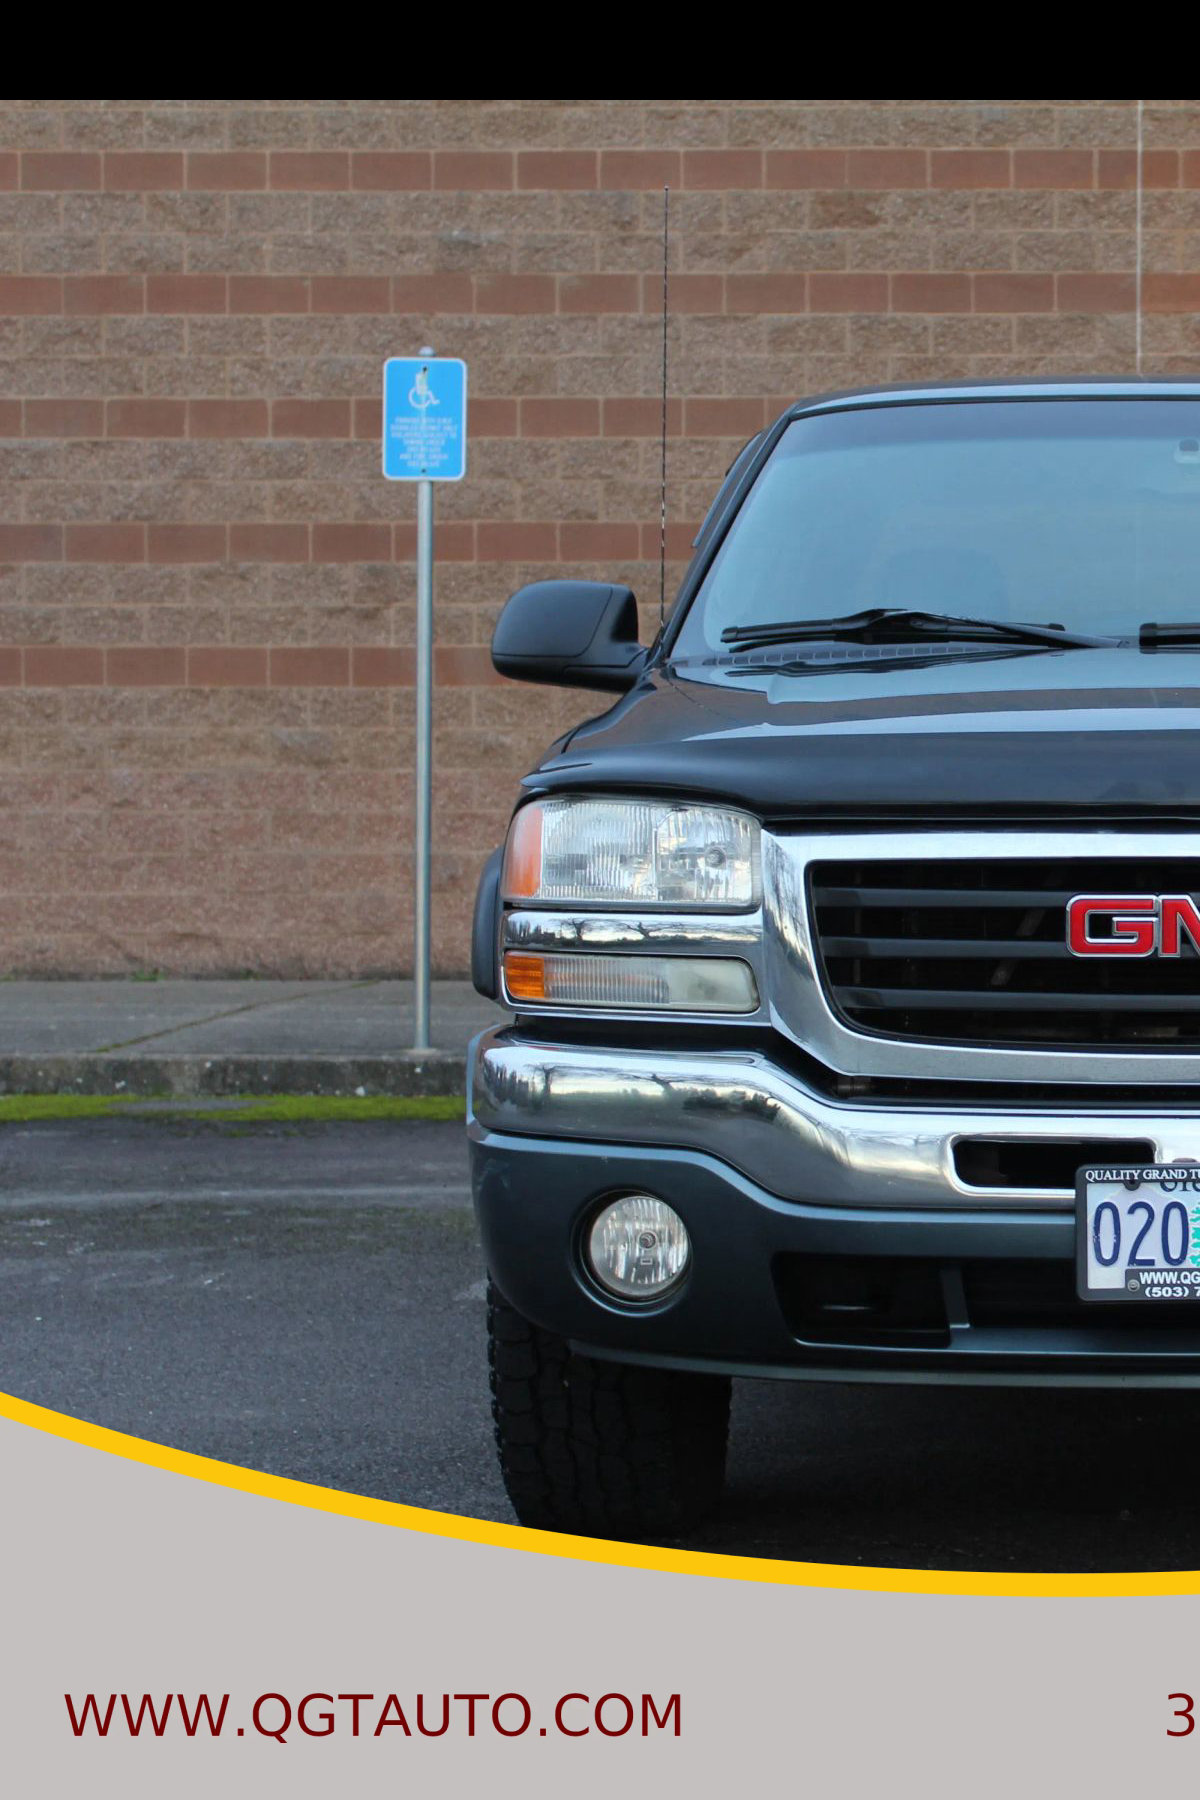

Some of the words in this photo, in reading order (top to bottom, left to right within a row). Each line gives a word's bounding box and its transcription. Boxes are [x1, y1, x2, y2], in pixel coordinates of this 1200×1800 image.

[1085, 1169, 1140, 1182] QUALITY
[1143, 1169, 1187, 1180] GRAND
[1093, 1201, 1189, 1266] 020
[1145, 1286, 1189, 1297] (503)
